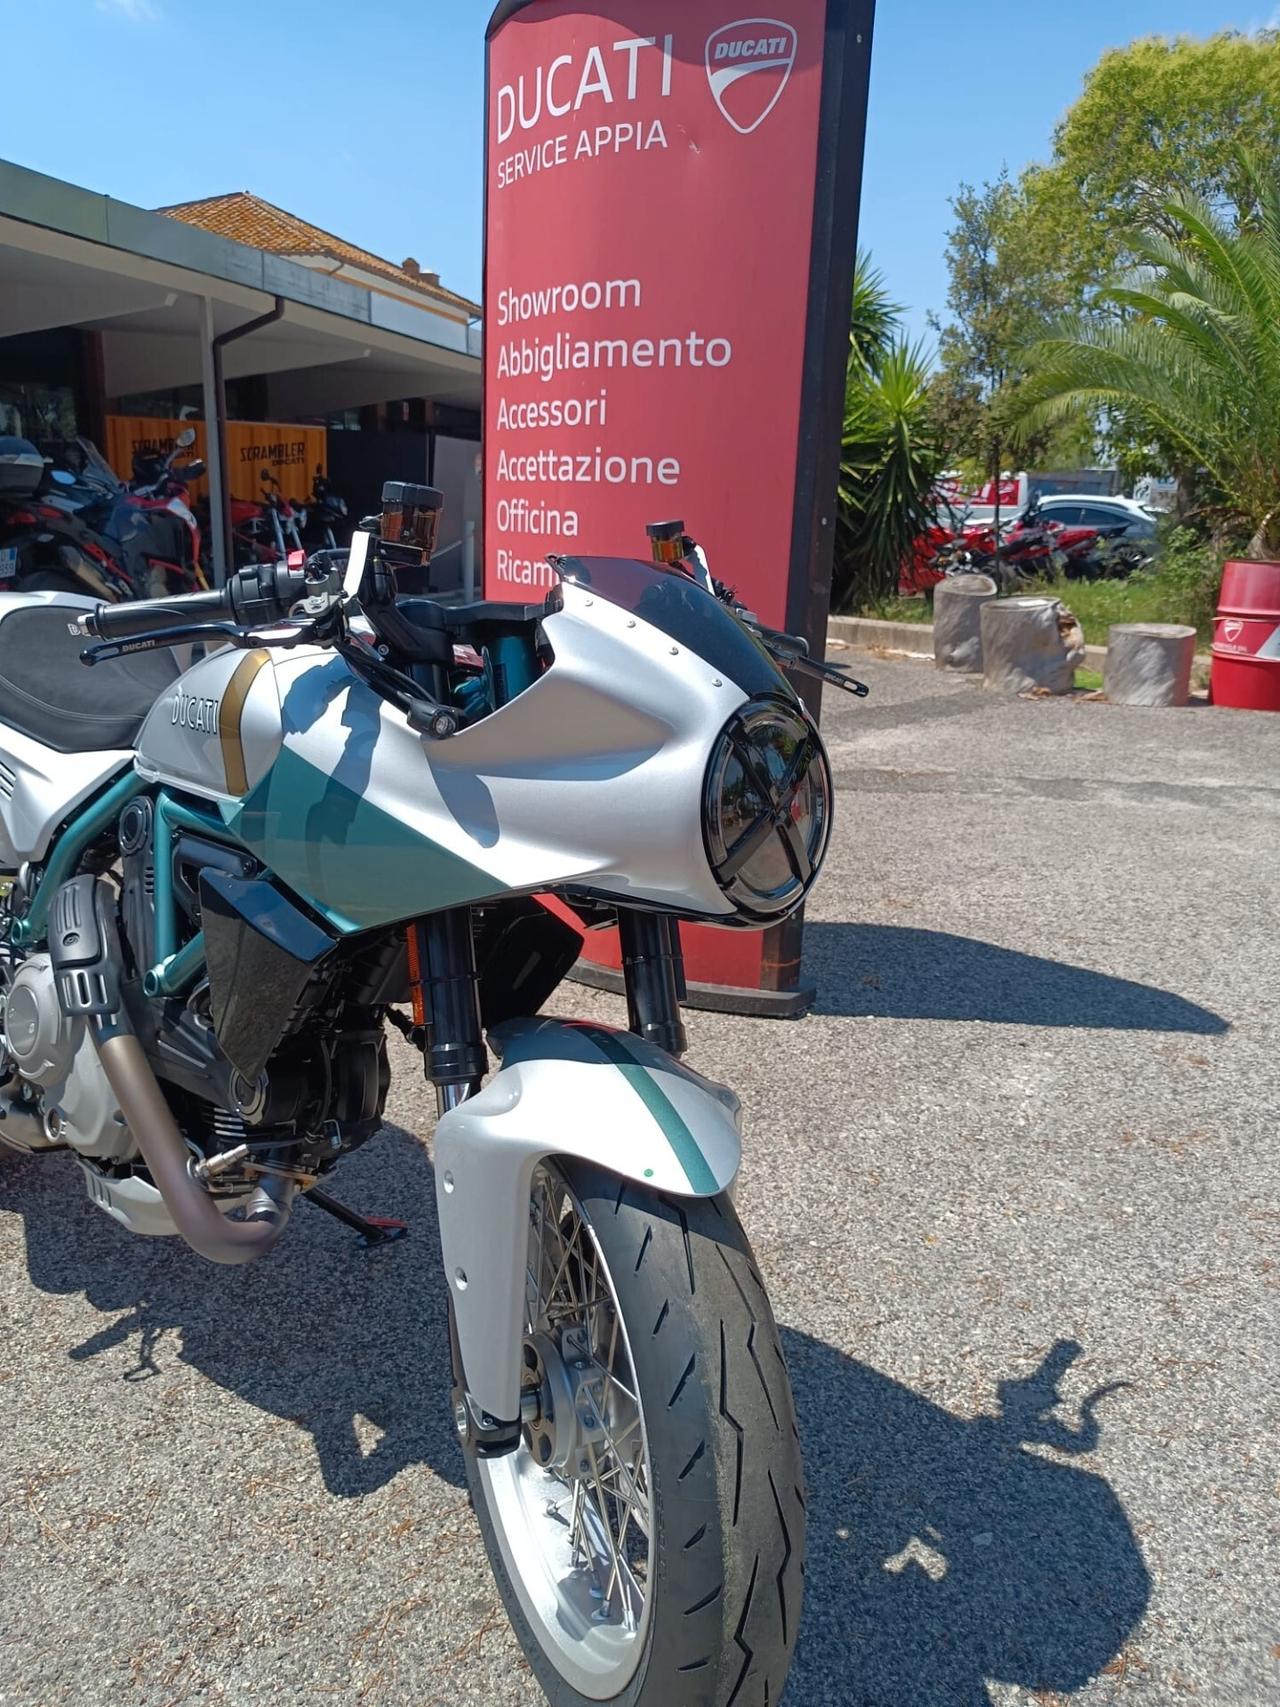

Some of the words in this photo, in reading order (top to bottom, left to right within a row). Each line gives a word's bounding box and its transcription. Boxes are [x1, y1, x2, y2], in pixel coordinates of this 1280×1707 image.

[714, 37, 787, 59] DUCATI
[497, 34, 673, 144] DUCATI
[497, 134, 568, 189] SERVICE
[574, 120, 669, 160] APPIA
[497, 278, 642, 326] Showroom
[497, 331, 733, 382] Abbigliamento
[497, 389, 607, 430] Accessori
[240, 442, 305, 462] SCRAMBLER
[497, 447, 681, 485] Accettazione
[497, 498, 579, 537] Officina
[497, 549, 560, 587] Ricam
[122, 640, 155, 652] DUCATI
[171, 693, 219, 735] DUCATI
